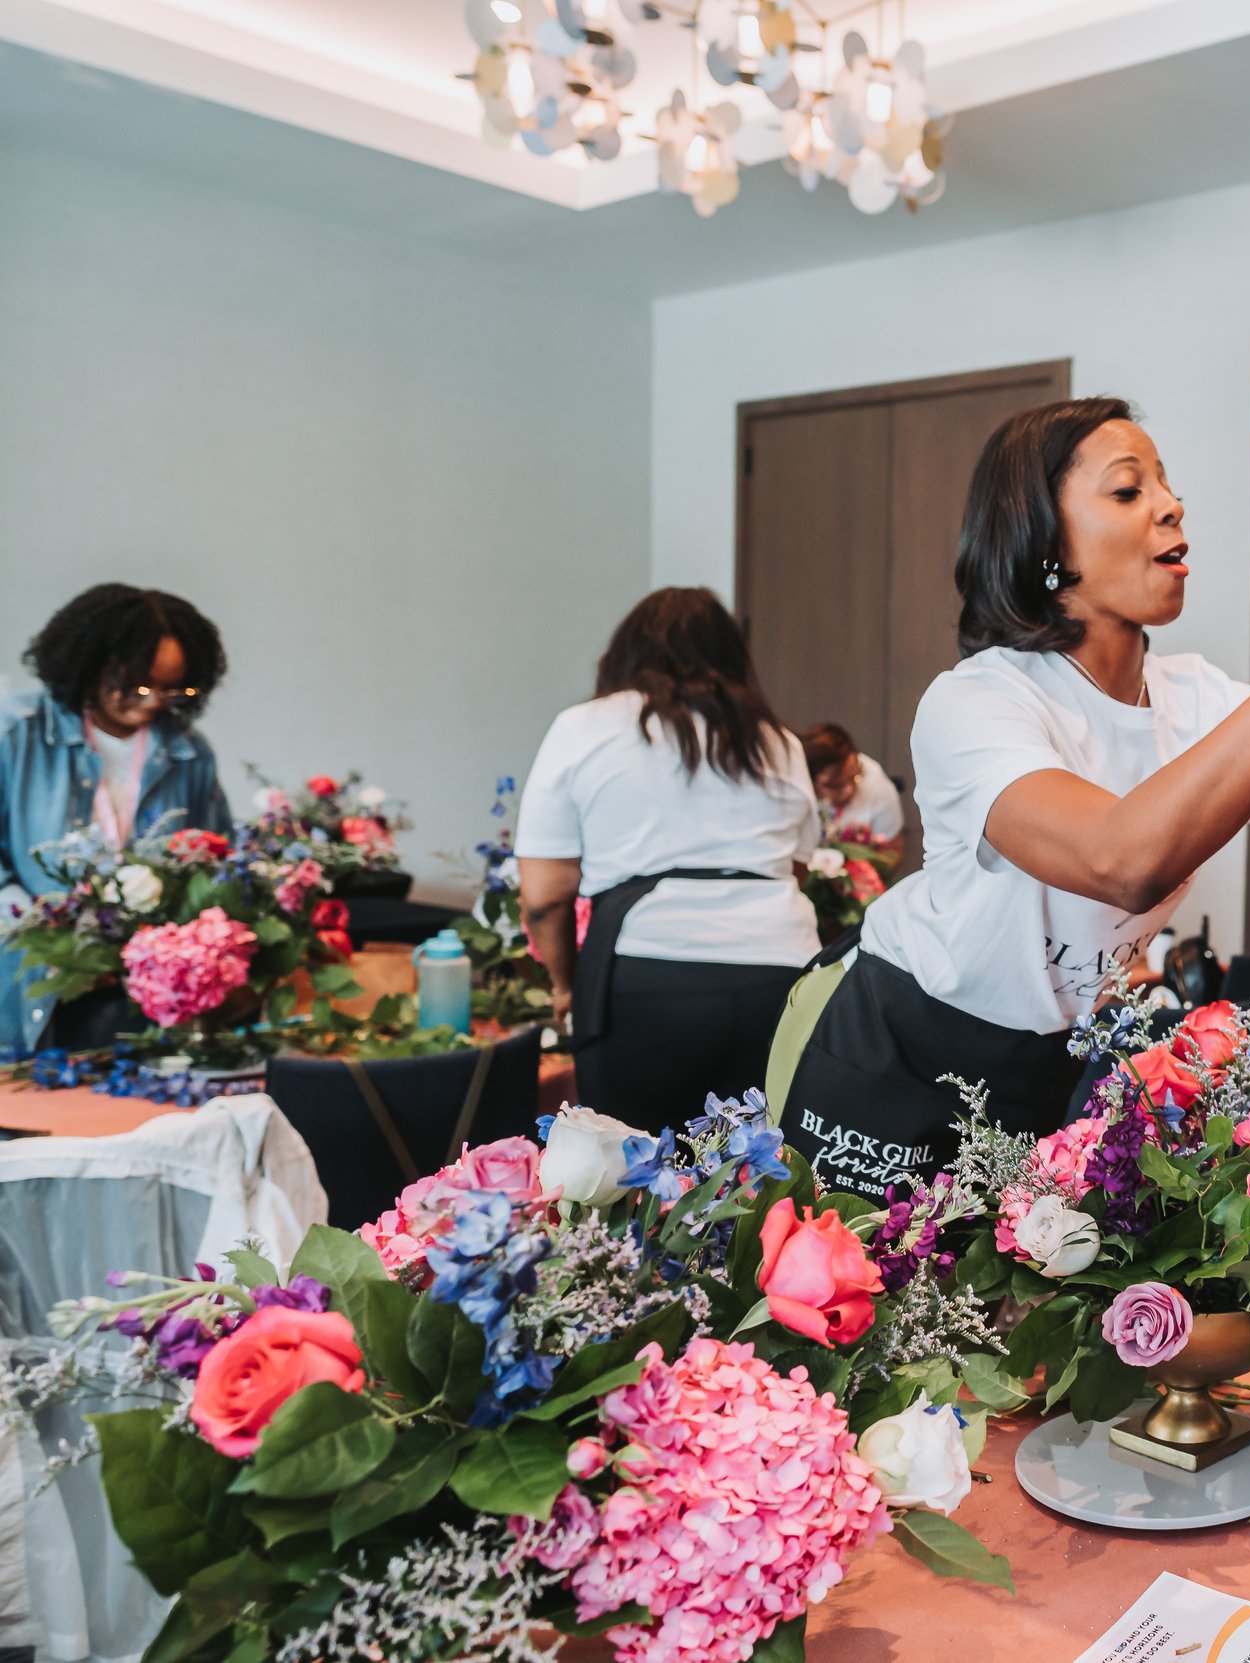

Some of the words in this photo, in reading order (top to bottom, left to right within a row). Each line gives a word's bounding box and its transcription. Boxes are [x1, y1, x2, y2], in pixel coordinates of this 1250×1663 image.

[800, 1109, 880, 1158] BLACK
[882, 1143, 934, 1167] GIRL
[836, 1174, 855, 1189] EST.
[858, 1181, 885, 1196] 2020
[1138, 1613, 1157, 1630] YOUR
[1129, 1625, 1163, 1655] HORIZONS
[1146, 1646, 1159, 1656] DO
[1156, 1632, 1175, 1647] BEST.
